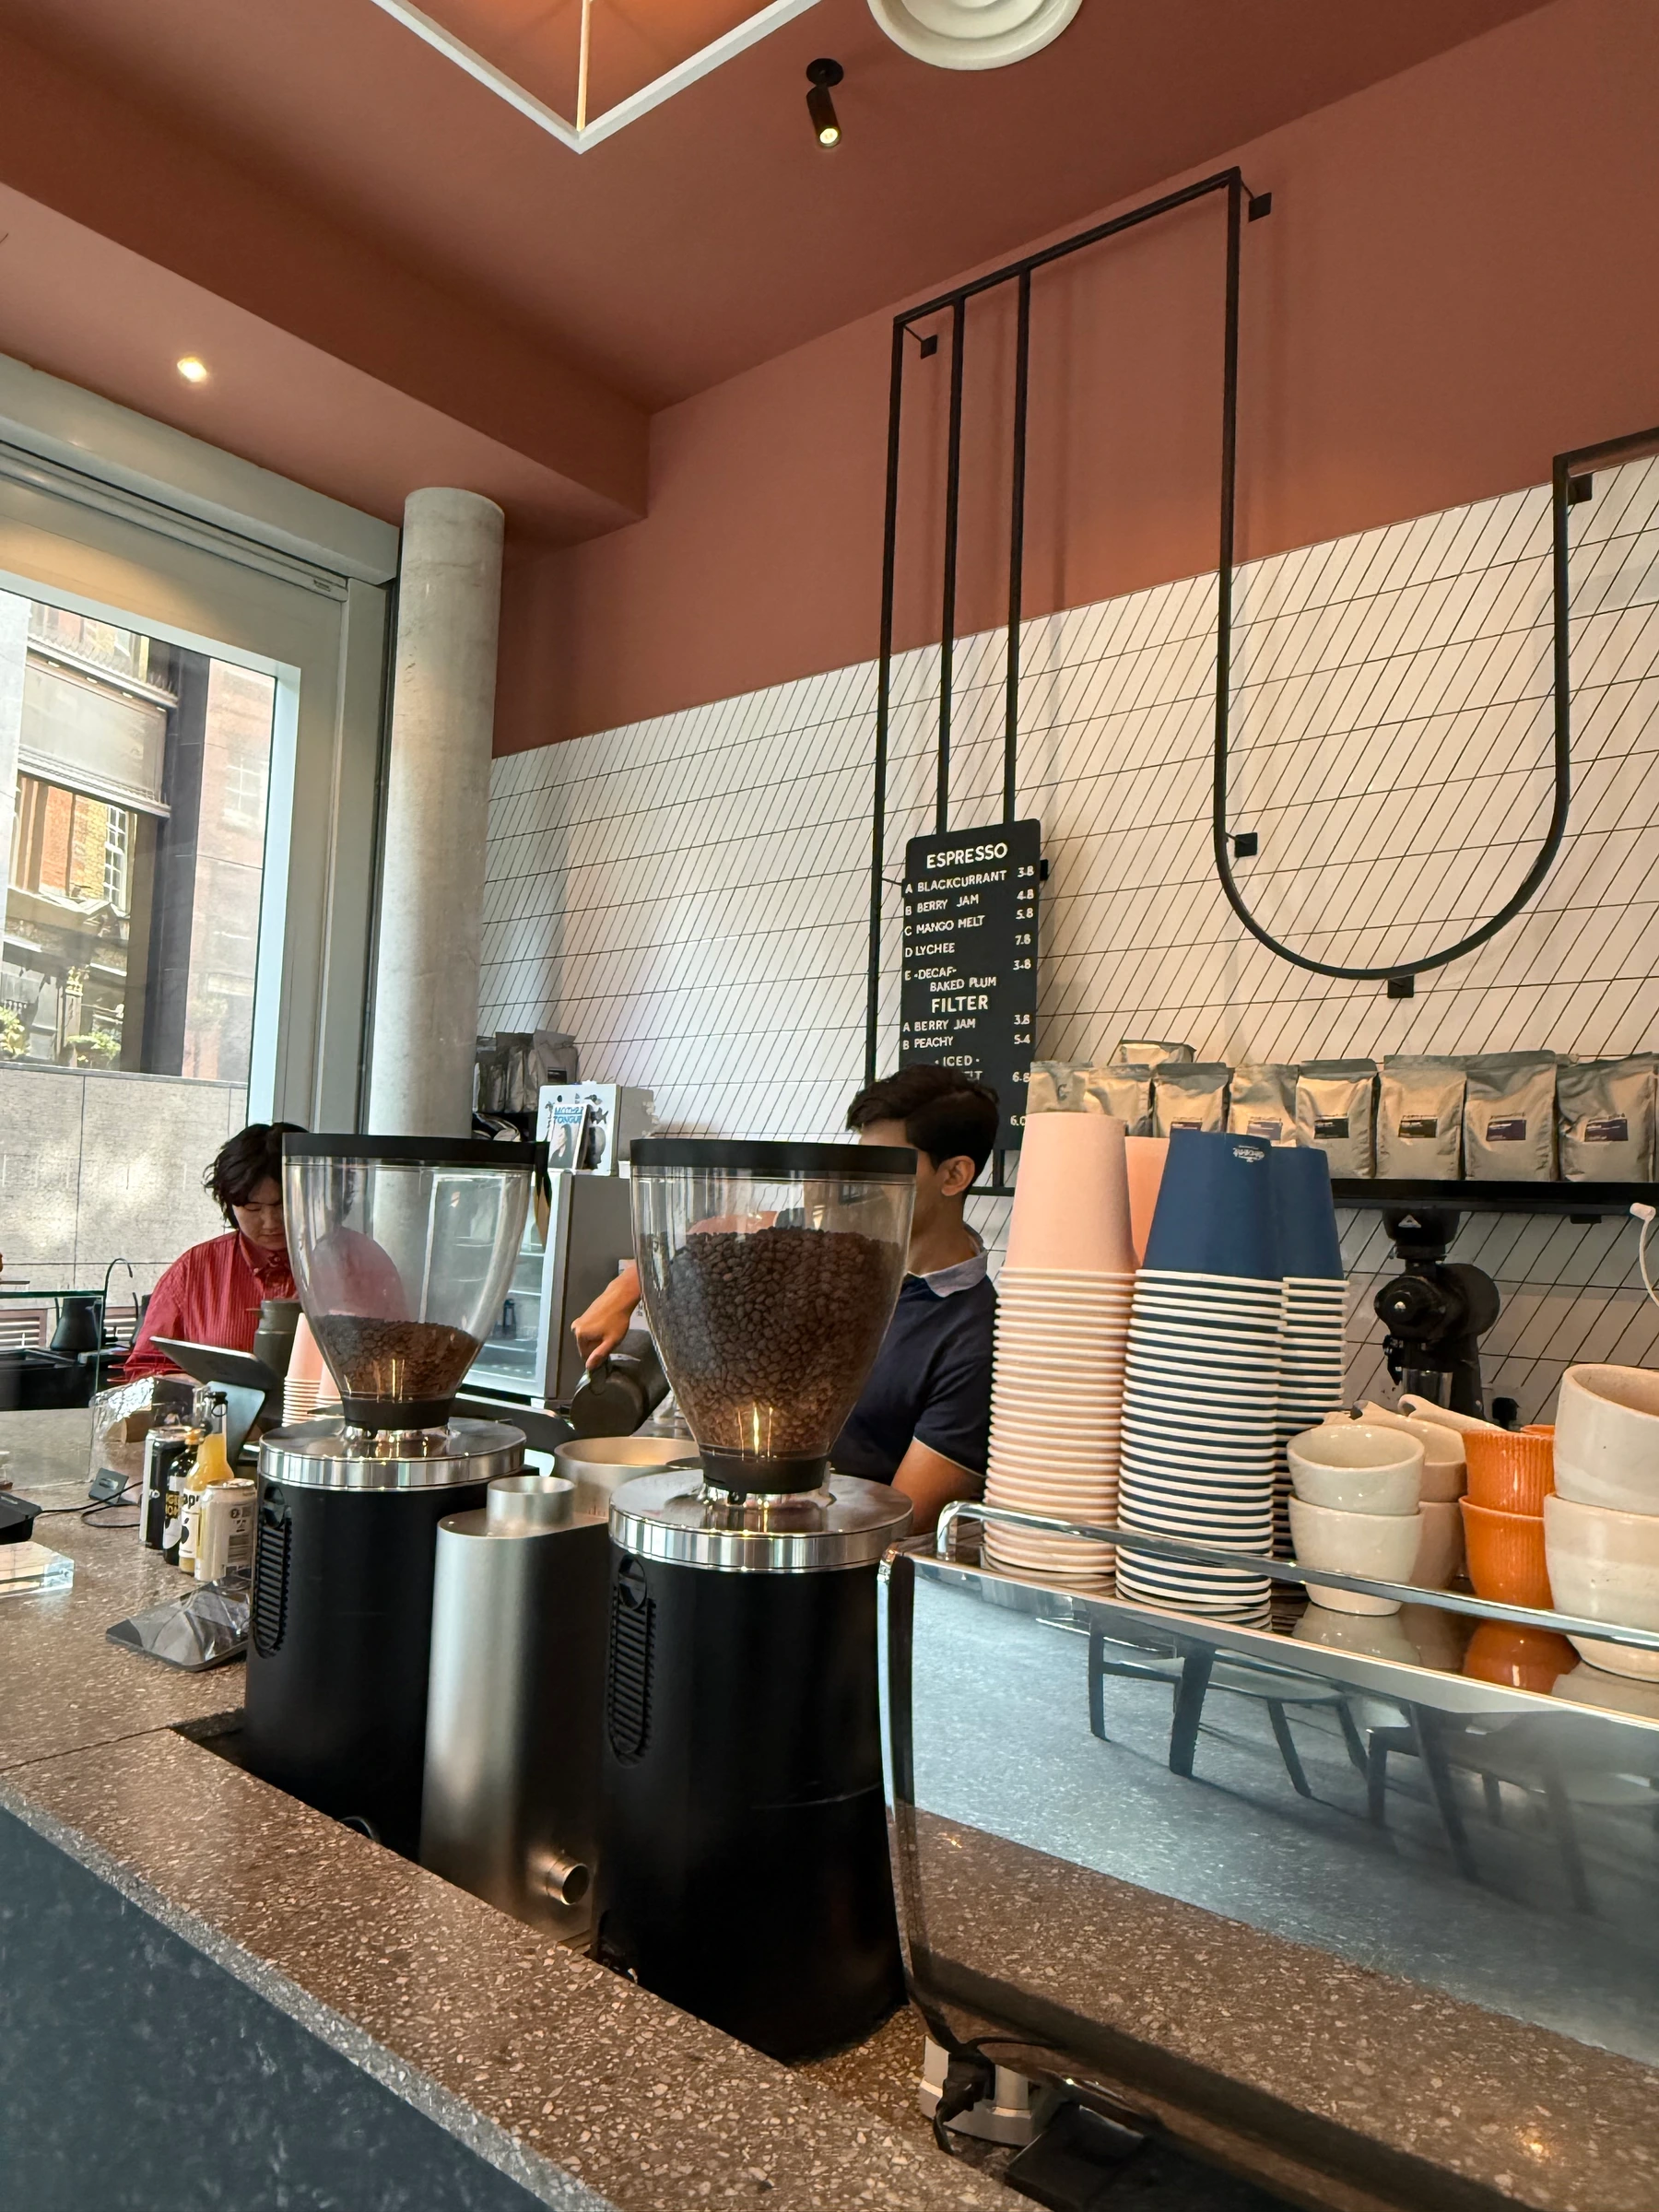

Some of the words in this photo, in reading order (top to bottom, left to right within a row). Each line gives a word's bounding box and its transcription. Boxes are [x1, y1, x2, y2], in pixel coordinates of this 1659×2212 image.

[926, 842, 1008, 869] ESPRESSO
[904, 883, 913, 894] A
[917, 870, 1007, 892] BLACKCURRANT
[1017, 865, 1034, 877] 3.8
[904, 905, 912, 916] B
[916, 899, 948, 913] BERRY
[956, 893, 980, 908] JAM
[1017, 888, 1034, 900] 4.8
[904, 925, 912, 936] C
[916, 920, 954, 935] MANGO
[958, 914, 986, 929] MELT
[1015, 907, 1034, 920] 5.8
[904, 947, 913, 958] D
[915, 942, 956, 957] LYCHEE
[1015, 934, 1031, 946] 7.8
[904, 970, 912, 981] E
[1013, 959, 1031, 971] 3.8
[929, 978, 965, 992] BAKED
[969, 976, 997, 988] PLUM
[931, 994, 988, 1014] FILTER
[902, 1021, 911, 1032] A
[914, 1018, 949, 1031] BERRY
[953, 1018, 976, 1030] JAM
[902, 1040, 910, 1050] B
[914, 1035, 954, 1048] PEACHY
